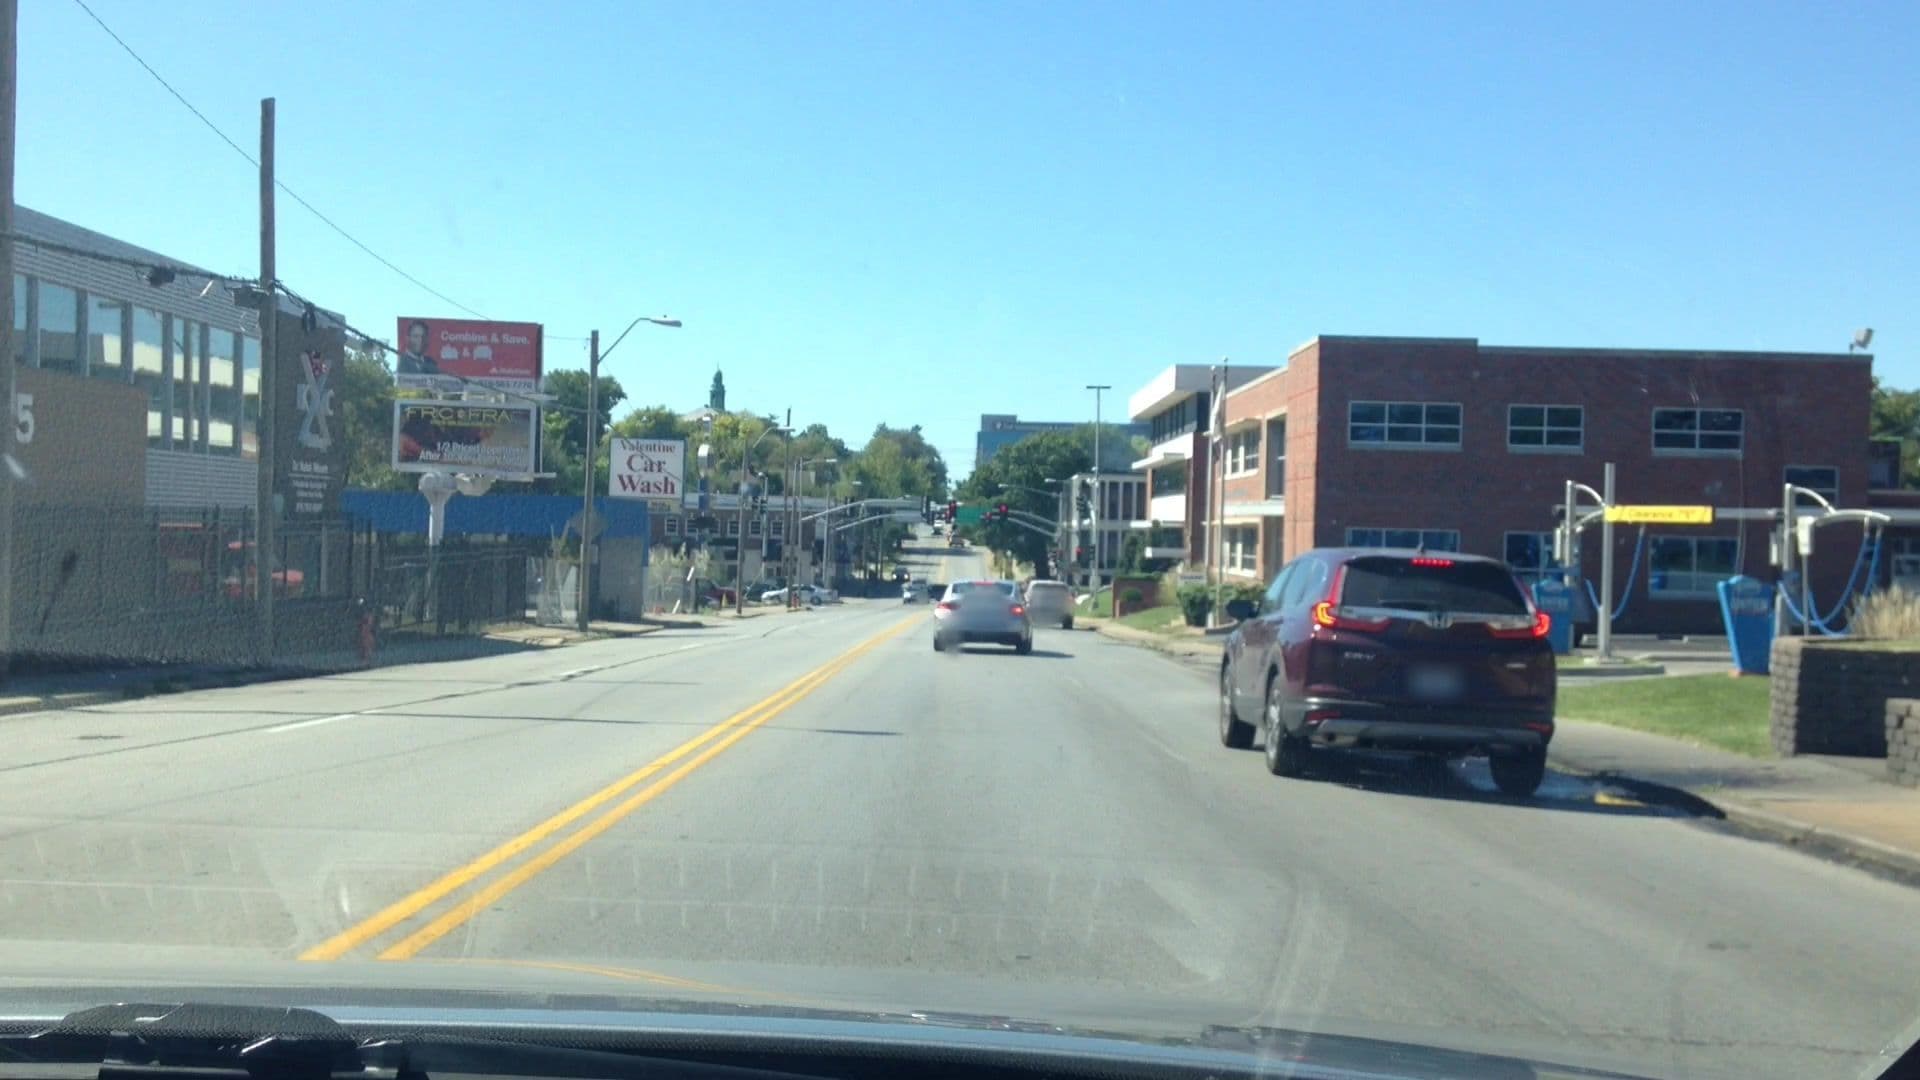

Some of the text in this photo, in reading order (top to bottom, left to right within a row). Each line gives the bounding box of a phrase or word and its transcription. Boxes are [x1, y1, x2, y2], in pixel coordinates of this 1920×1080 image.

[440, 330, 488, 344] Combine
[617, 439, 676, 454] Valentine
[626, 453, 667, 473] Car
[617, 474, 676, 495] Wash
